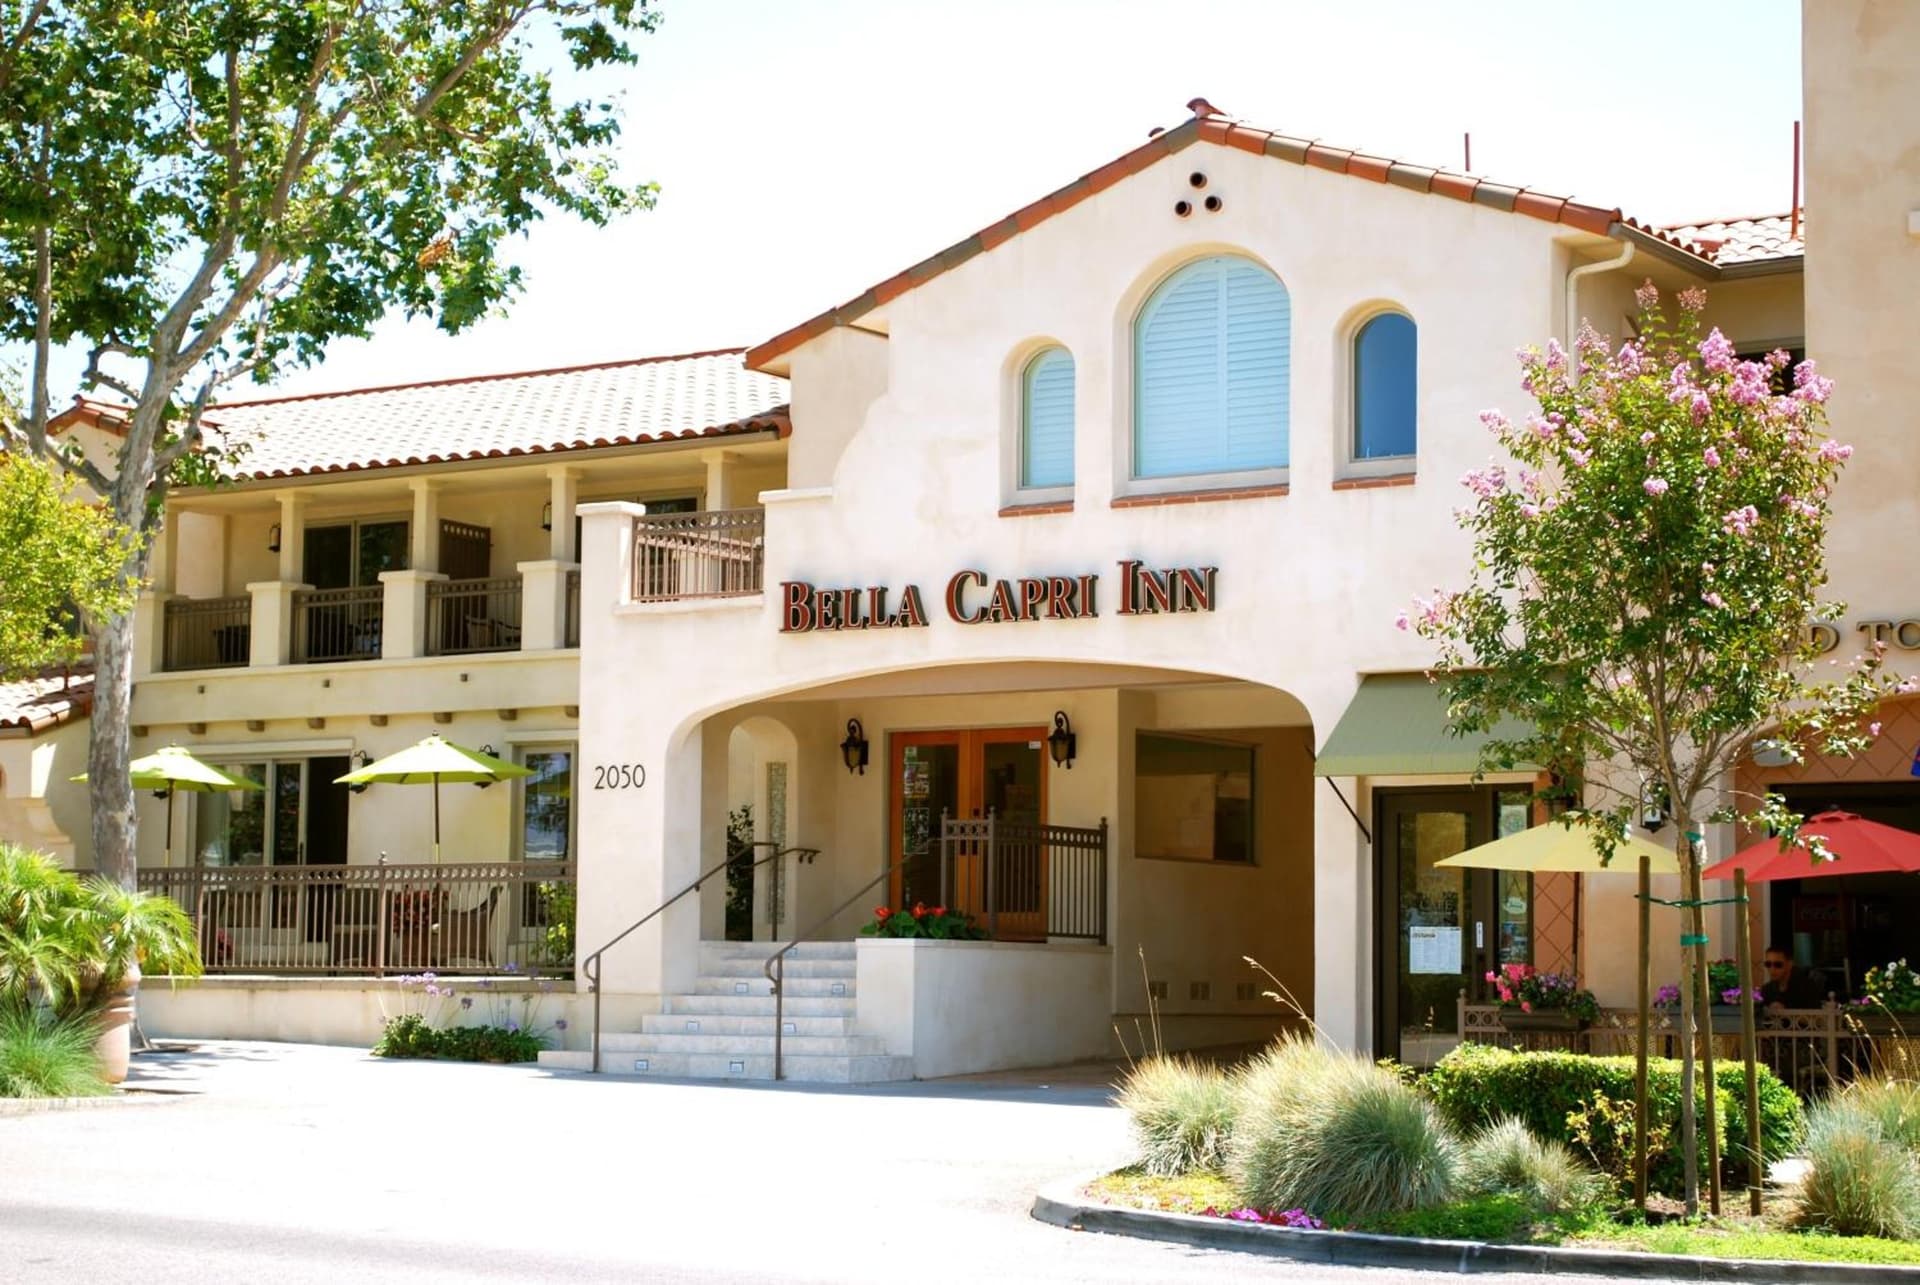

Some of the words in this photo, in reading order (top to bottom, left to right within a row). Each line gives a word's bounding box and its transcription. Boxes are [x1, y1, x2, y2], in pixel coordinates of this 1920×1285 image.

[780, 580, 930, 633] BELLA
[945, 570, 1099, 624] CAPRI
[1116, 559, 1218, 615] INN
[594, 764, 646, 790] 2050
